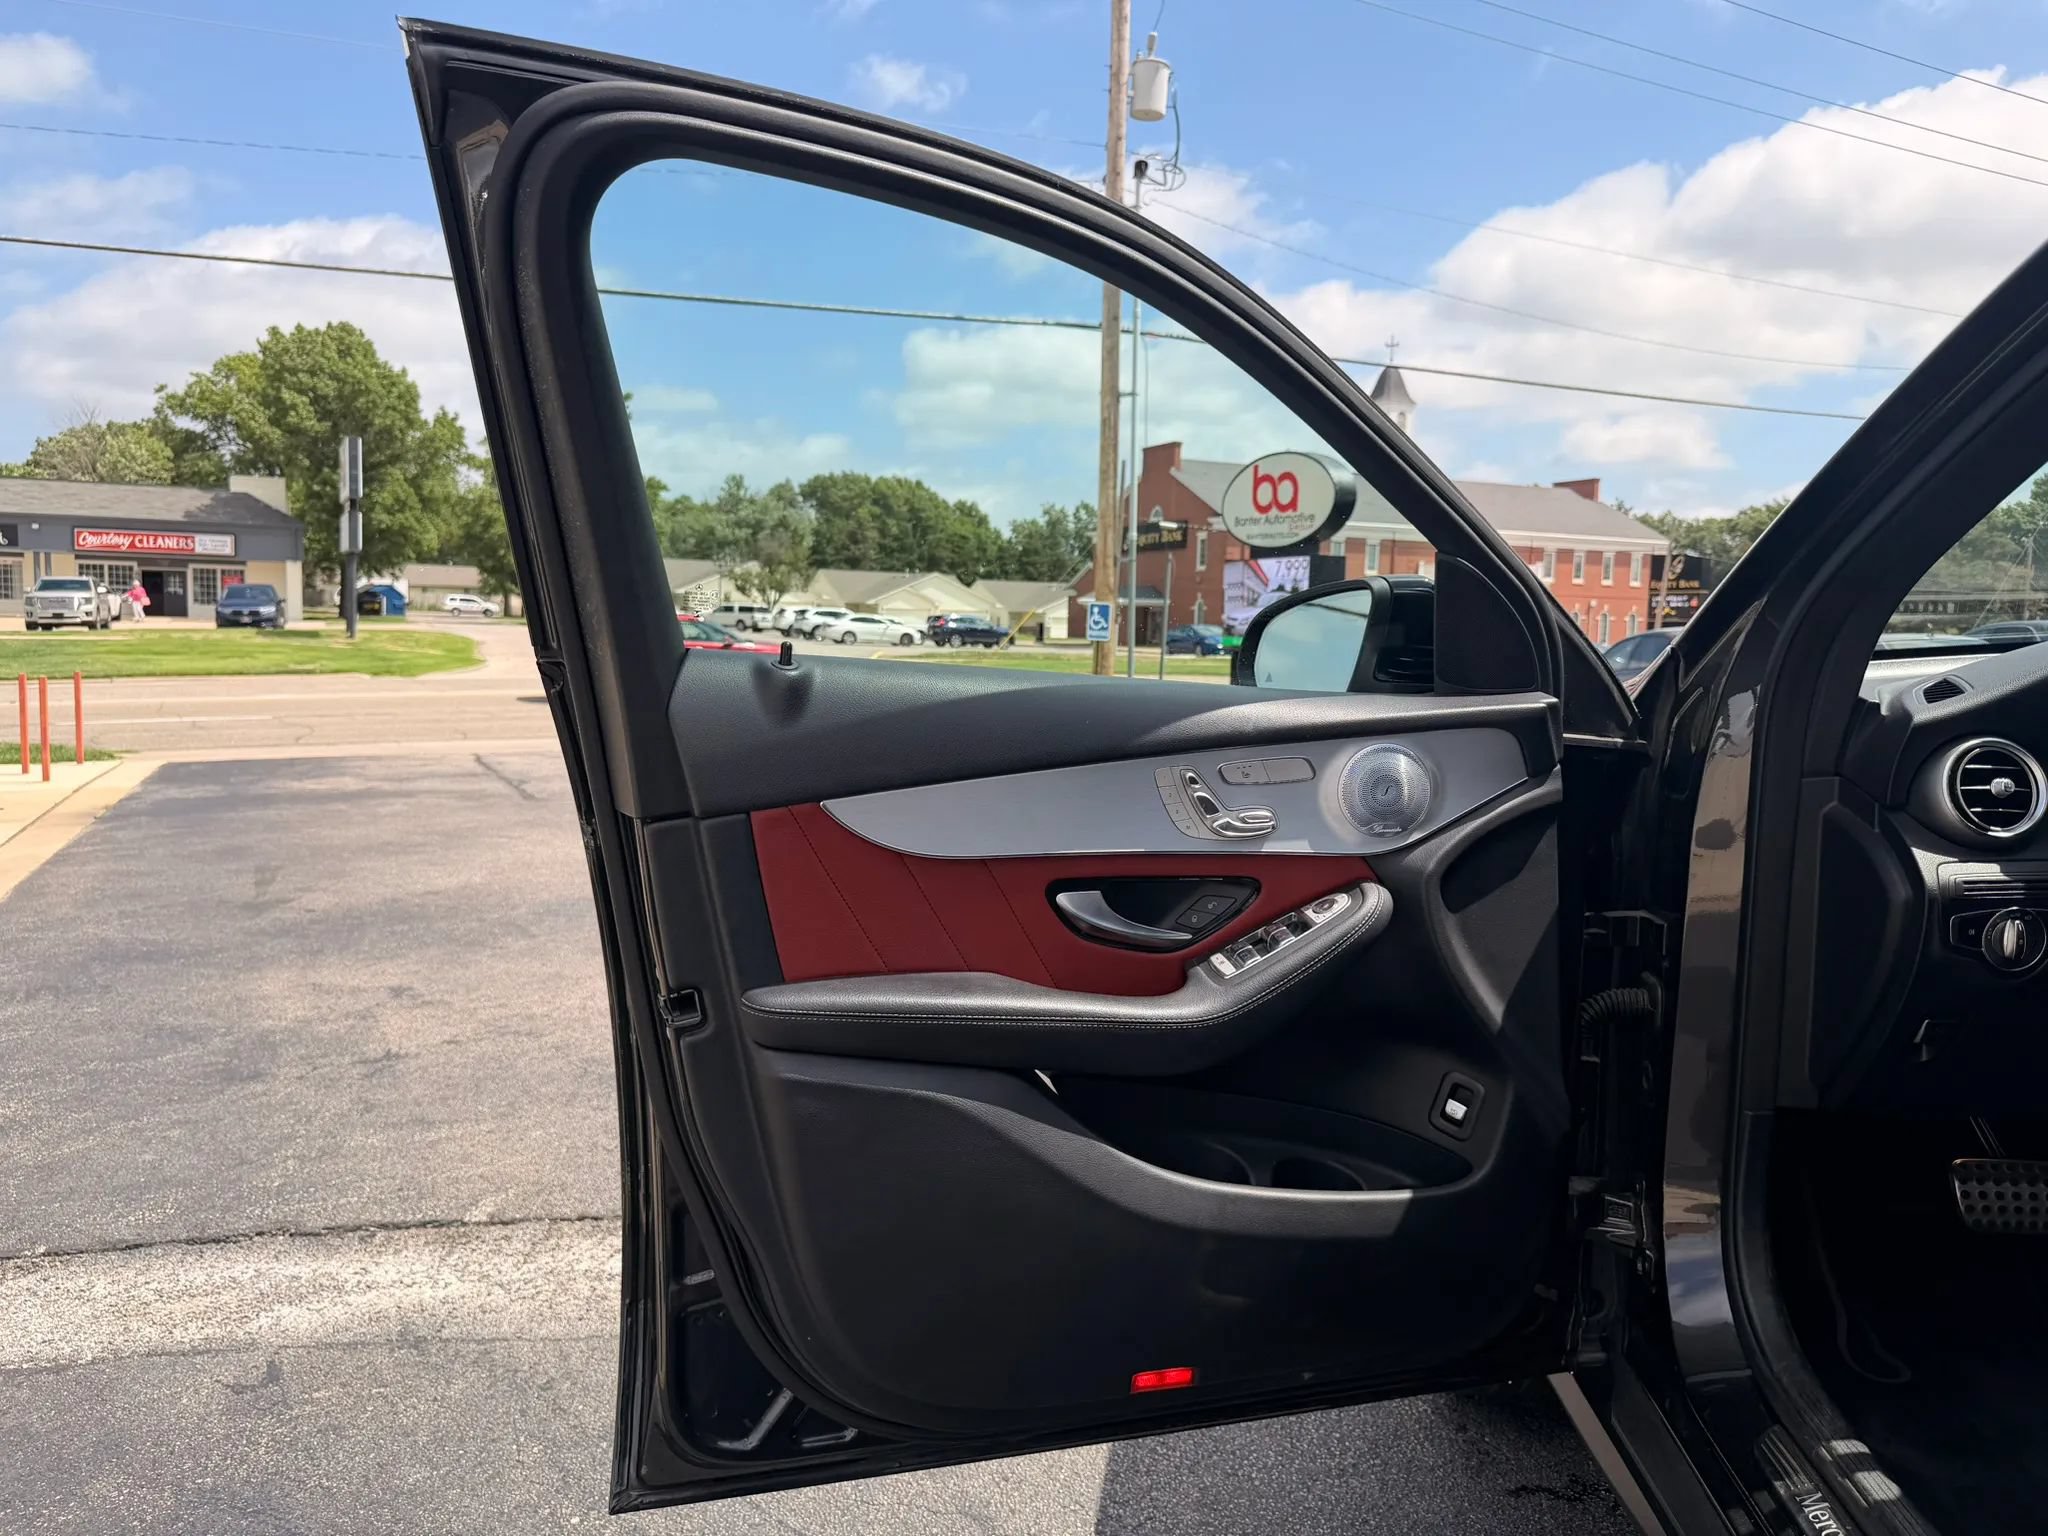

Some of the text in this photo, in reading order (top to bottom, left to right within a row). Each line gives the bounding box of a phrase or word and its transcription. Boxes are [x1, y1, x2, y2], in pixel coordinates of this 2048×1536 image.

[1234, 512, 1316, 527] Banter Automotive
[78, 532, 133, 551] Courtesy
[134, 535, 194, 550] CLEANERS
